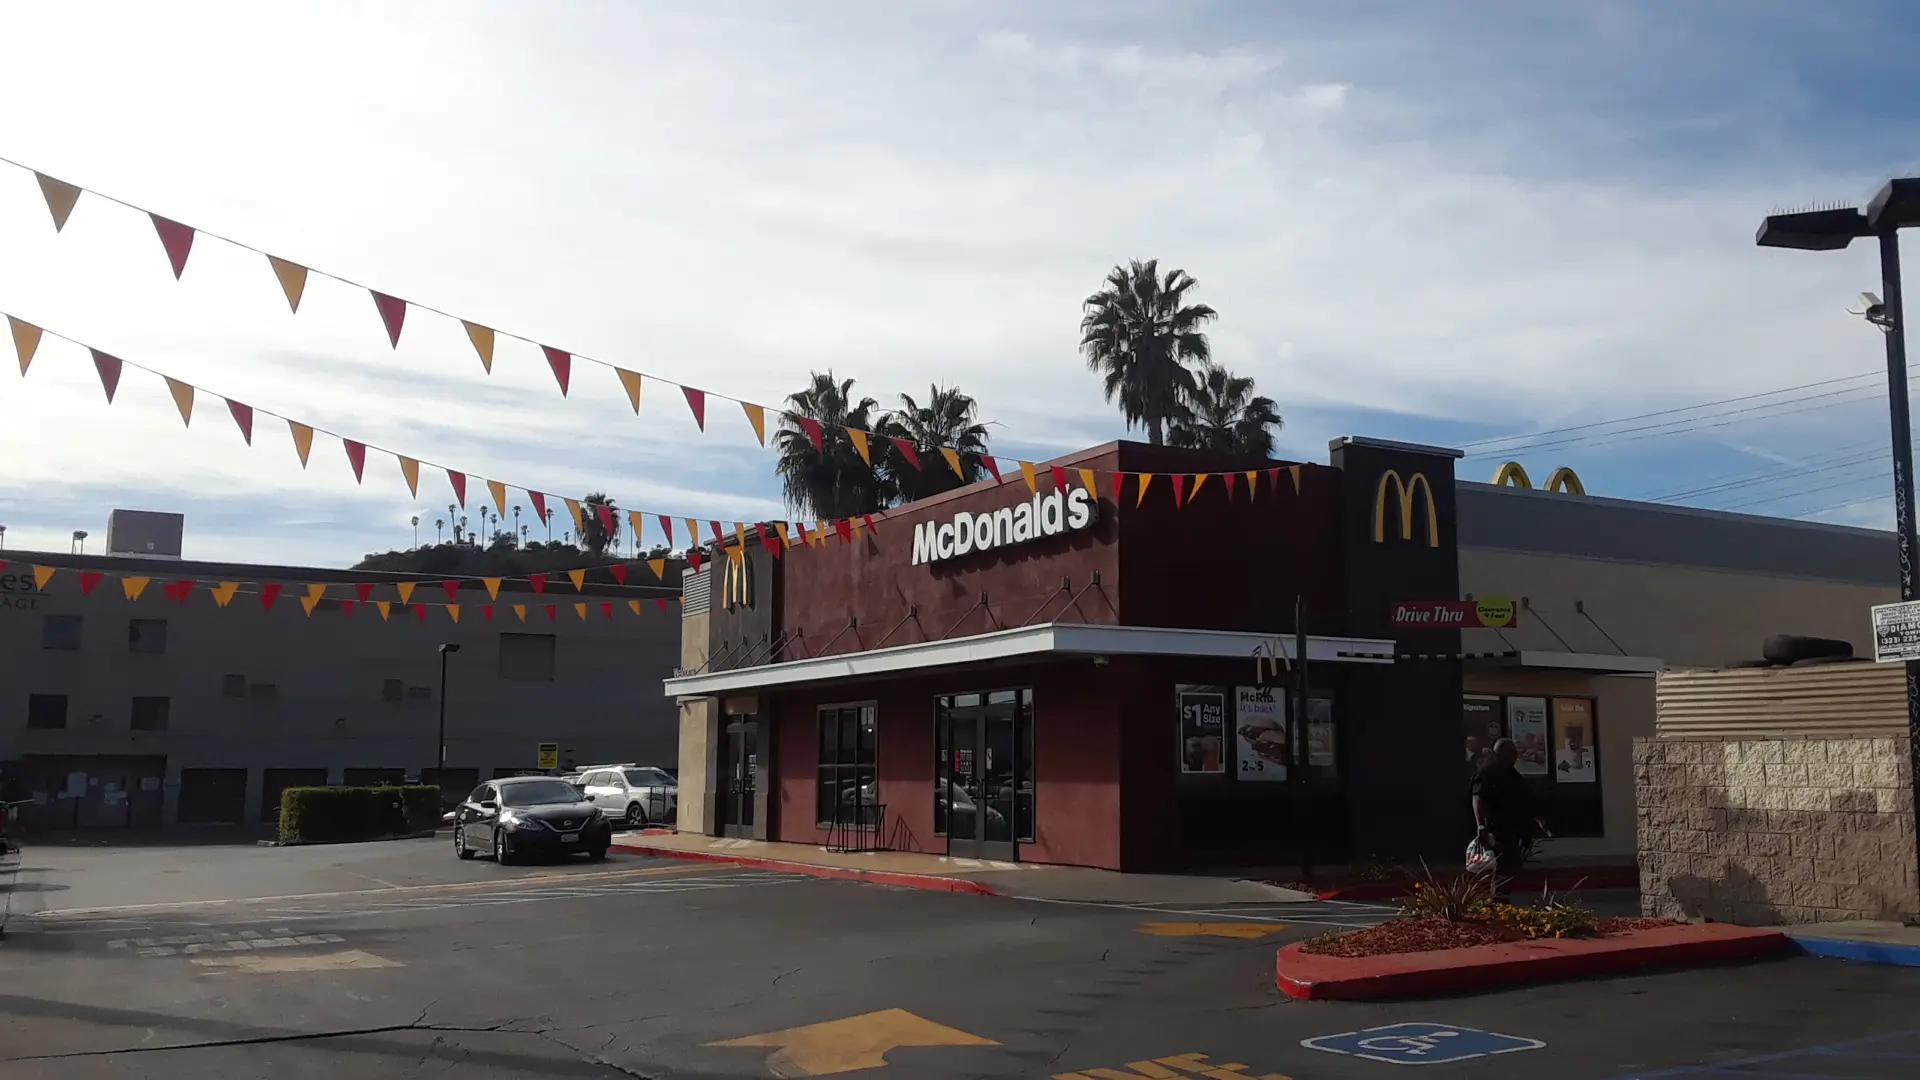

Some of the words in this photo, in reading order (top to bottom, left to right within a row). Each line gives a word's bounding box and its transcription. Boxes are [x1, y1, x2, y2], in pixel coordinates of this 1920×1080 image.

[912, 484, 1091, 566] McDonald's
[1395, 605, 1430, 622] Drive
[1433, 605, 1464, 622] Thru
[1183, 703, 1202, 727] $1
[1203, 704, 1221, 715] Any
[1203, 715, 1221, 724] Size
[1241, 760, 1249, 772] 2
